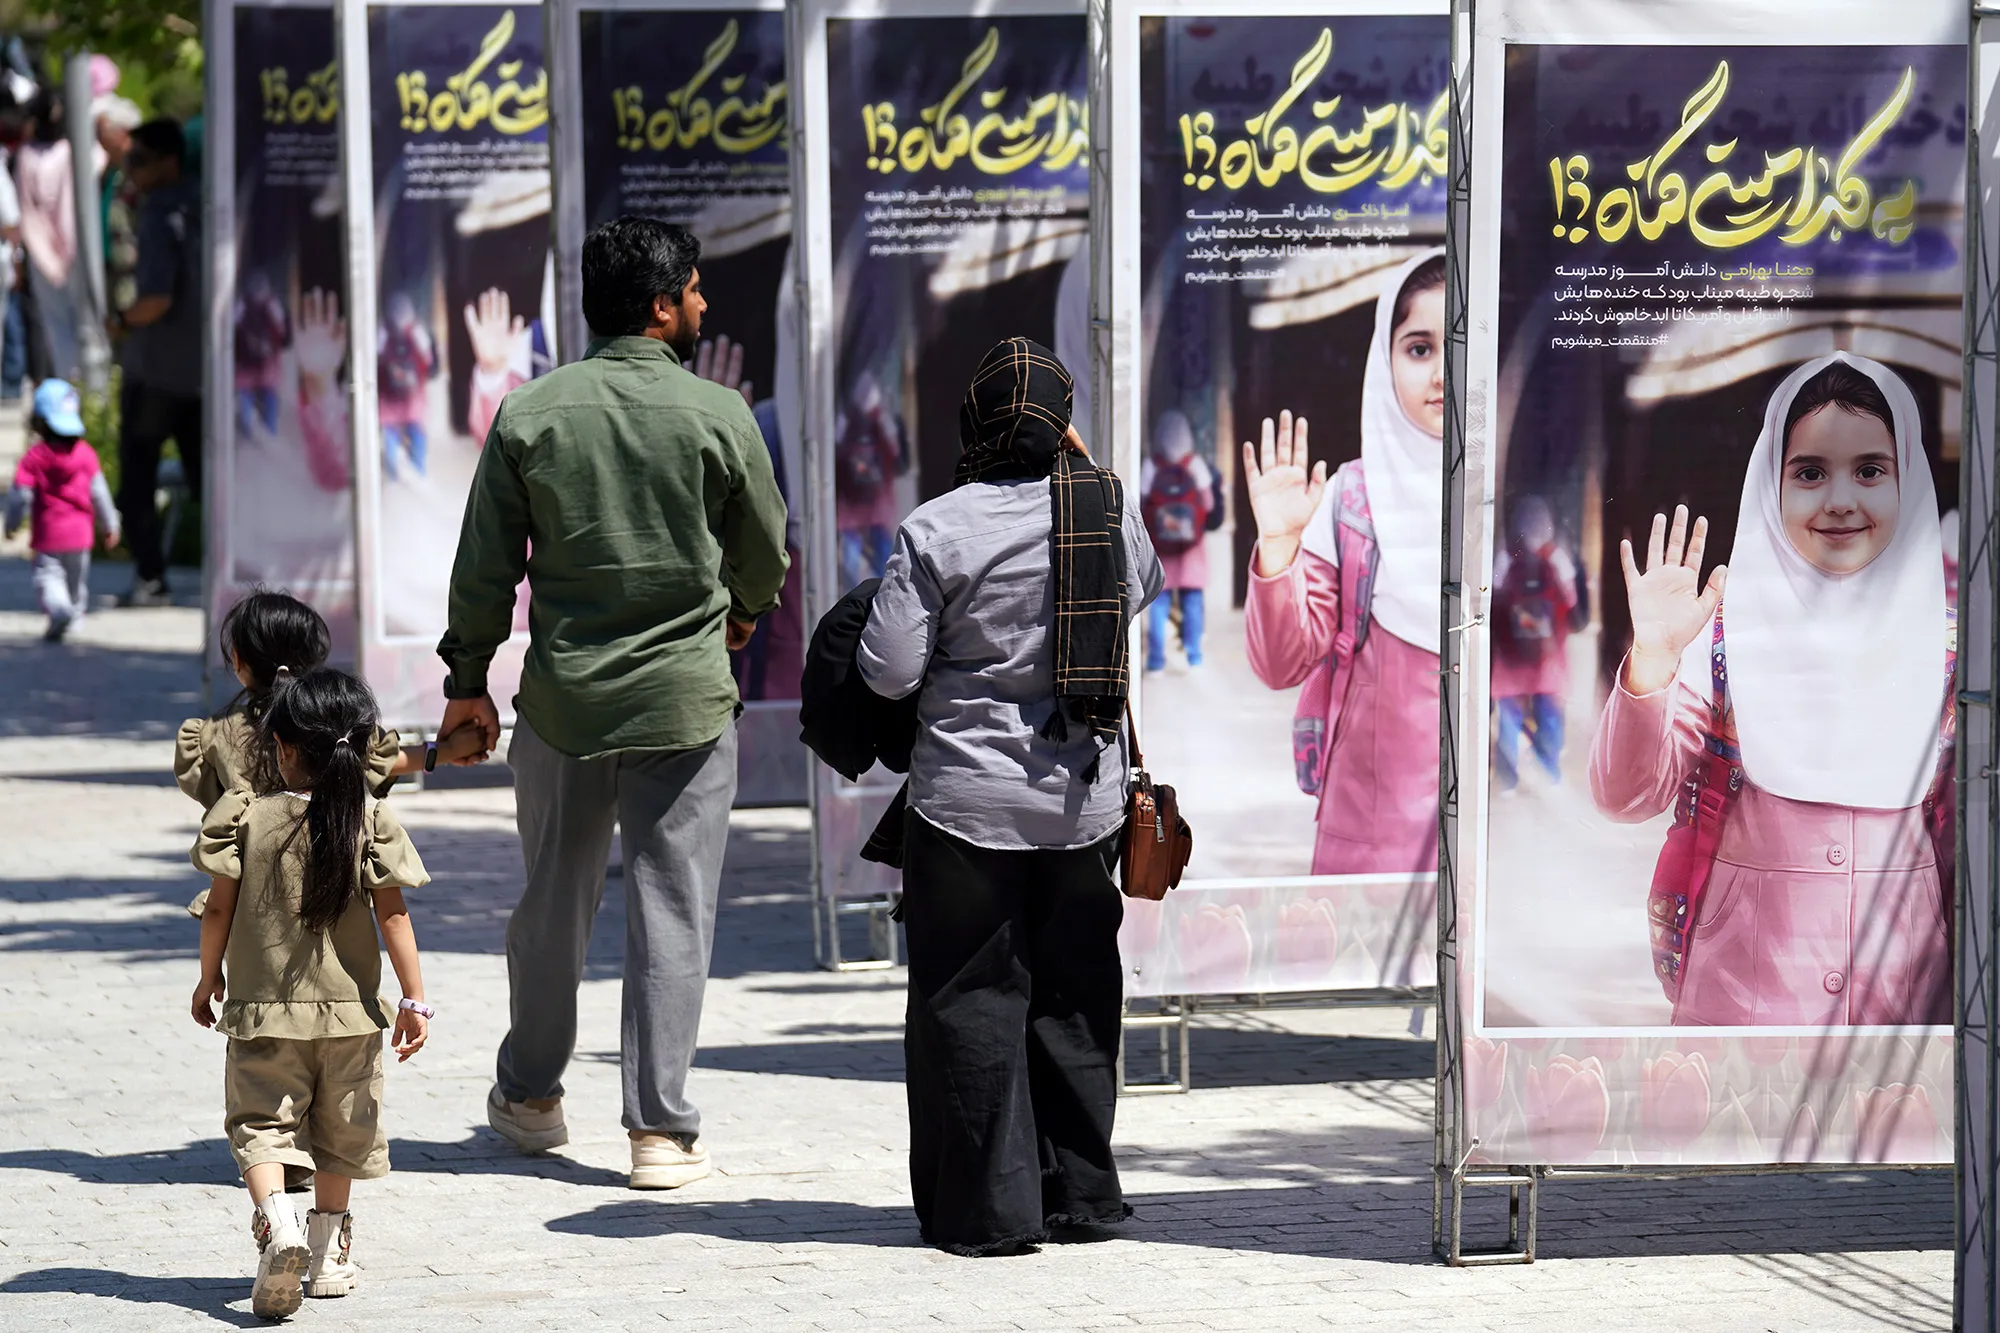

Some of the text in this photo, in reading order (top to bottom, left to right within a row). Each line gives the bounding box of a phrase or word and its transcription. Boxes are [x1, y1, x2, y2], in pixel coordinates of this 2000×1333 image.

[1186, 208, 1244, 223] مدرسه
[1244, 203, 1296, 222] آموز
[1296, 204, 1331, 221] دانش
[1261, 224, 1283, 239] که
[1554, 265, 1608, 280] مدرسه
[1609, 260, 1671, 280] آموز
[1672, 262, 1717, 280] دانش
[1720, 262, 1772, 280] بهرامی
[1642, 284, 1667, 299] که
[1668, 287, 1690, 303] بود
[1691, 284, 1734, 302] میناب
[1735, 284, 1771, 302] طیبه
[1772, 284, 1814, 303] شجره
[1553, 306, 1594, 325] کردند.
[1595, 307, 1652, 325] خاموش
[1651, 307, 1669, 324] ابد
[1671, 307, 1682, 321] تا
